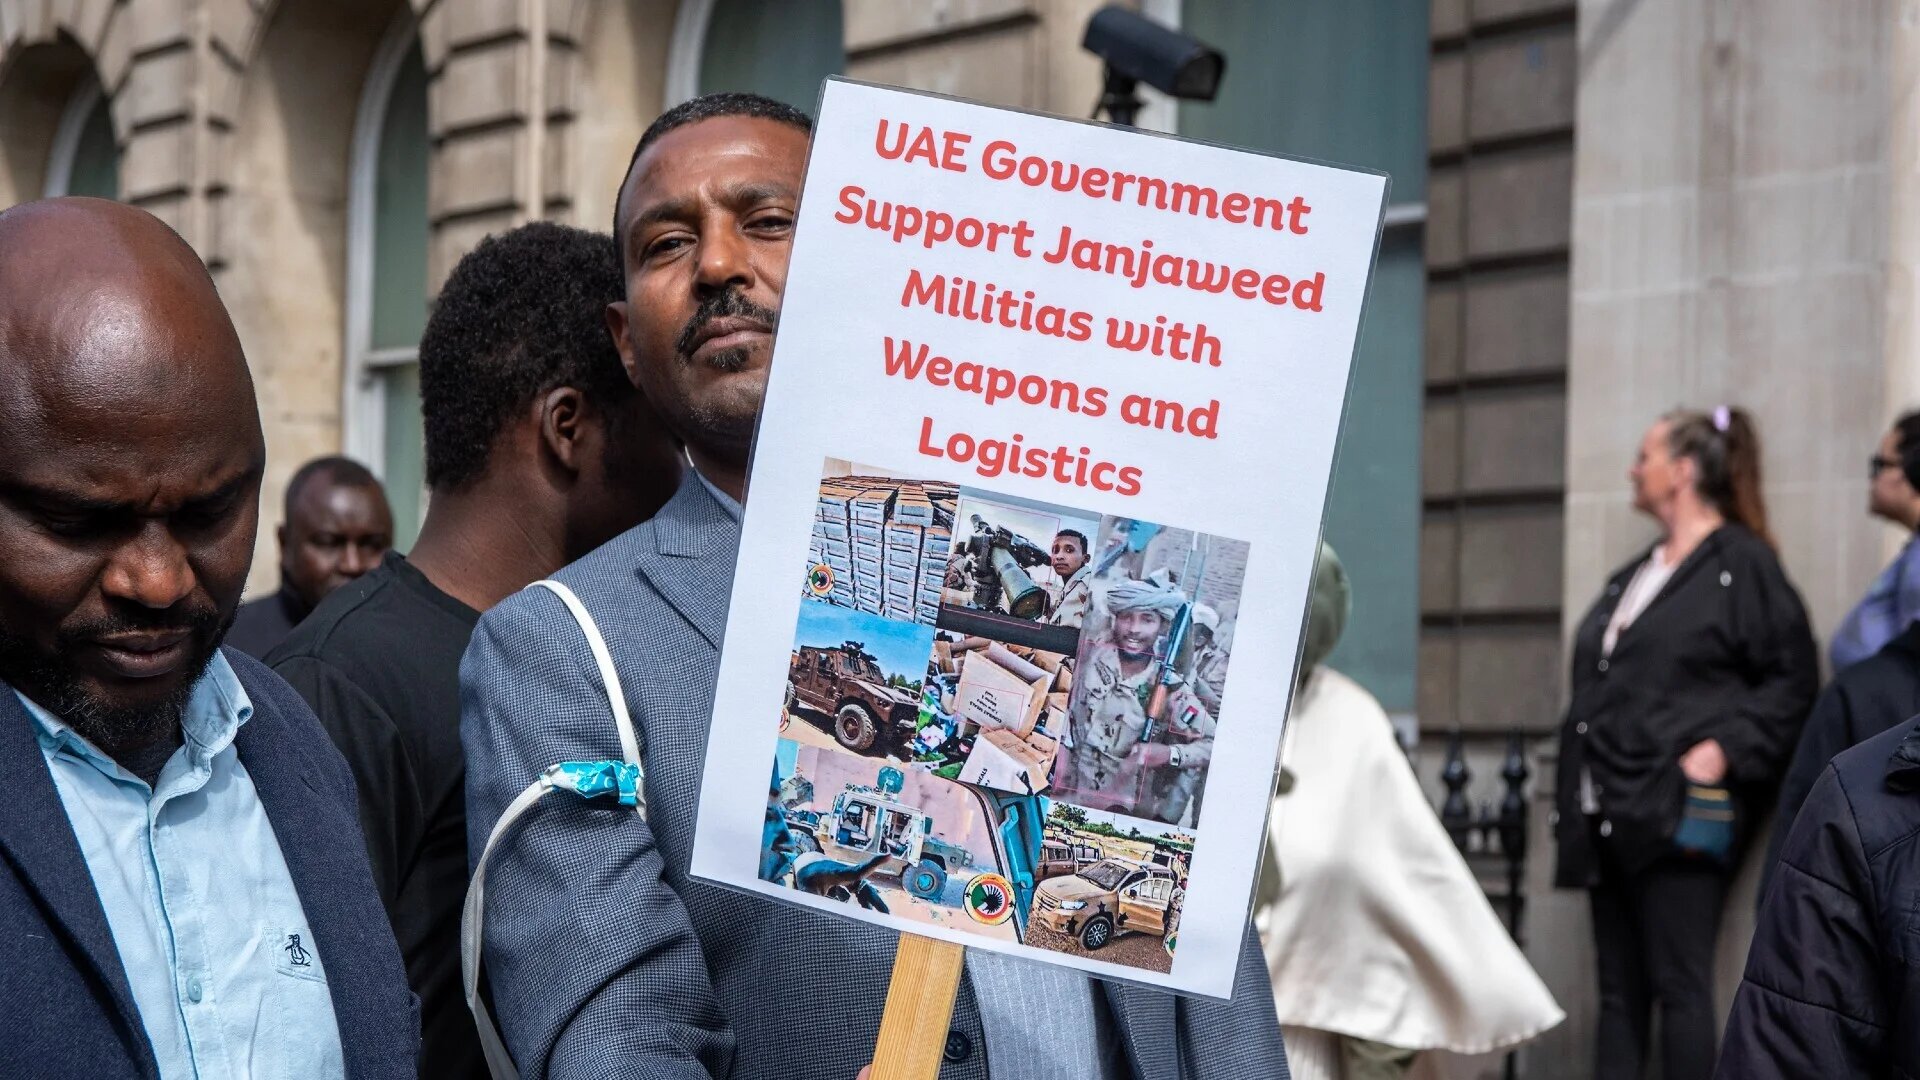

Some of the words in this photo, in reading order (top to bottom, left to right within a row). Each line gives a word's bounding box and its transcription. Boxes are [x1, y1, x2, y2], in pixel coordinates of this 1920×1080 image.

[875, 119, 971, 172] UAE
[982, 140, 1311, 235] Government
[835, 185, 1034, 258] Support
[1043, 226, 1325, 312] Janjaweed
[901, 270, 1093, 342] Militias
[1107, 315, 1222, 367] with
[884, 337, 1108, 417] Weapons
[1120, 395, 1220, 439] and
[918, 417, 1143, 497] Logistics
